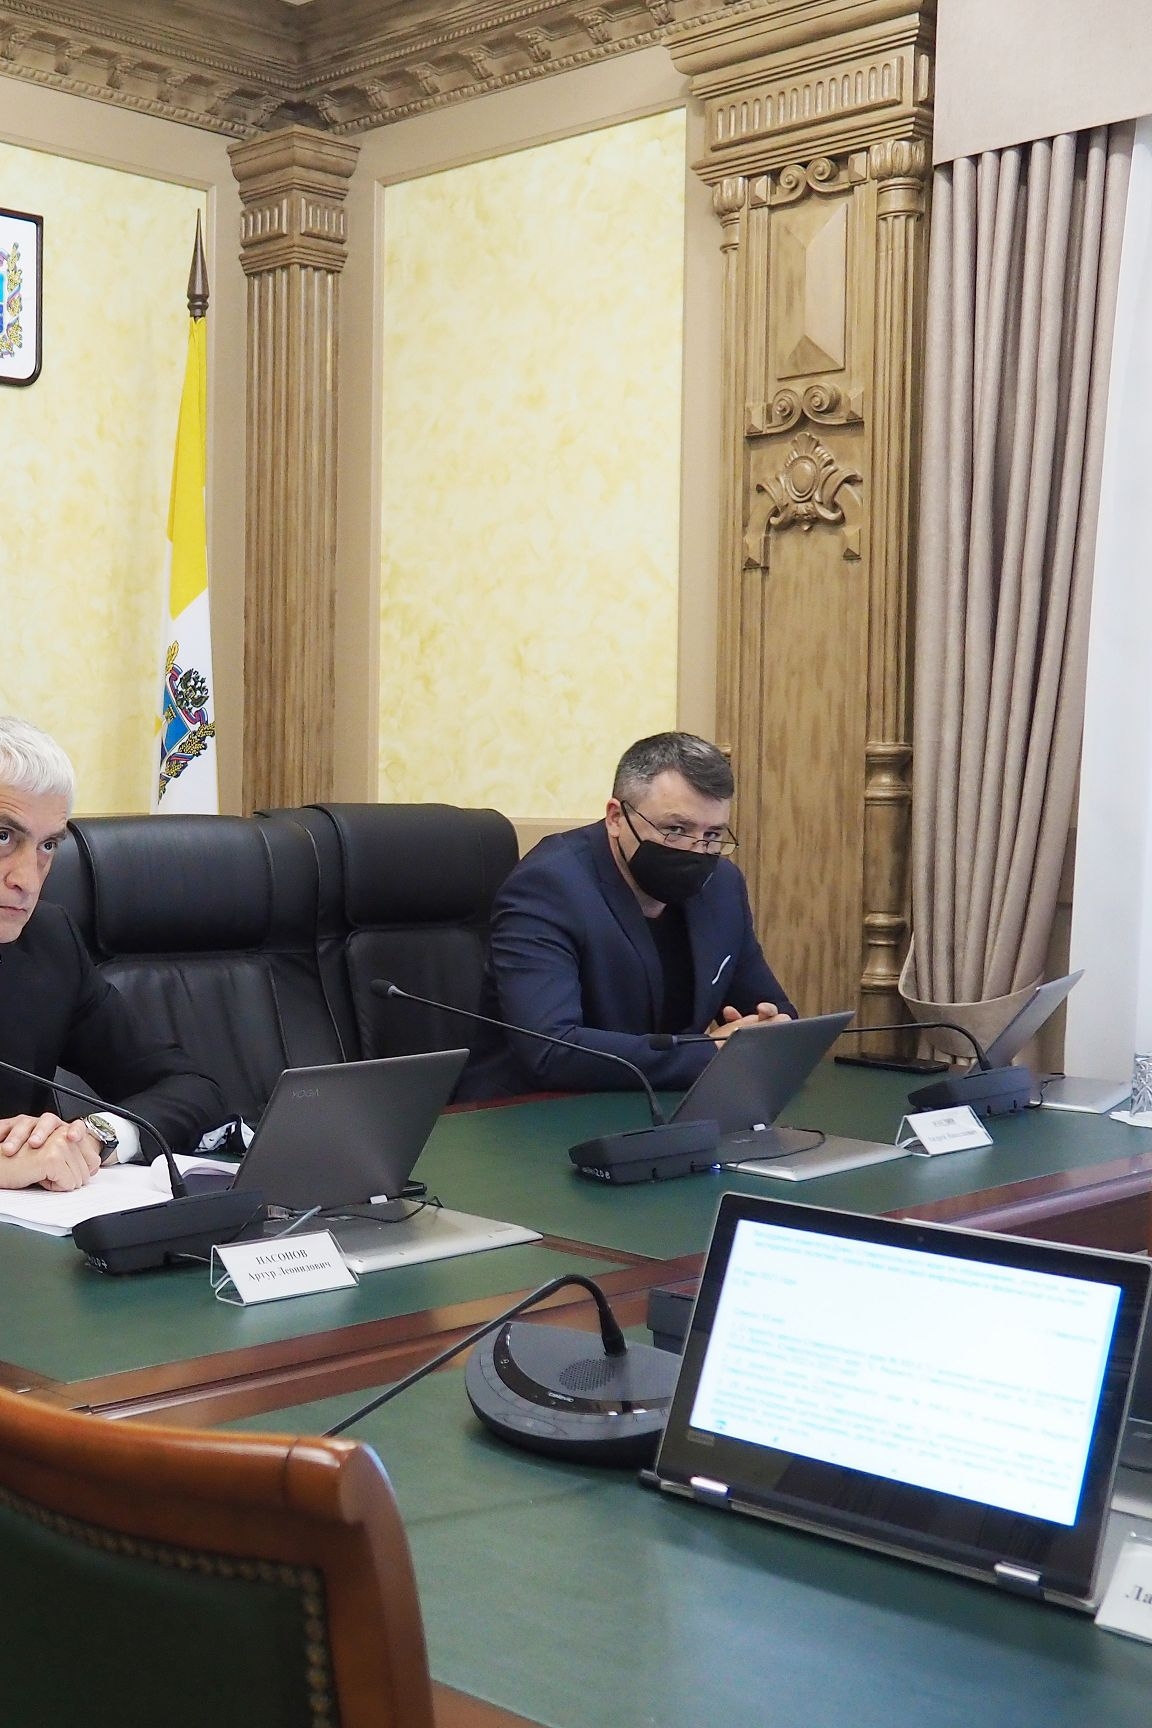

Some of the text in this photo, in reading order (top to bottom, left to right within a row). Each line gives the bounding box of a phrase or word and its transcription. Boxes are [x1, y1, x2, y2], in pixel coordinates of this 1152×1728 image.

[255, 1248, 308, 1265] НАСОНОВ
[248, 1261, 332, 1283] Артур Леонидович
